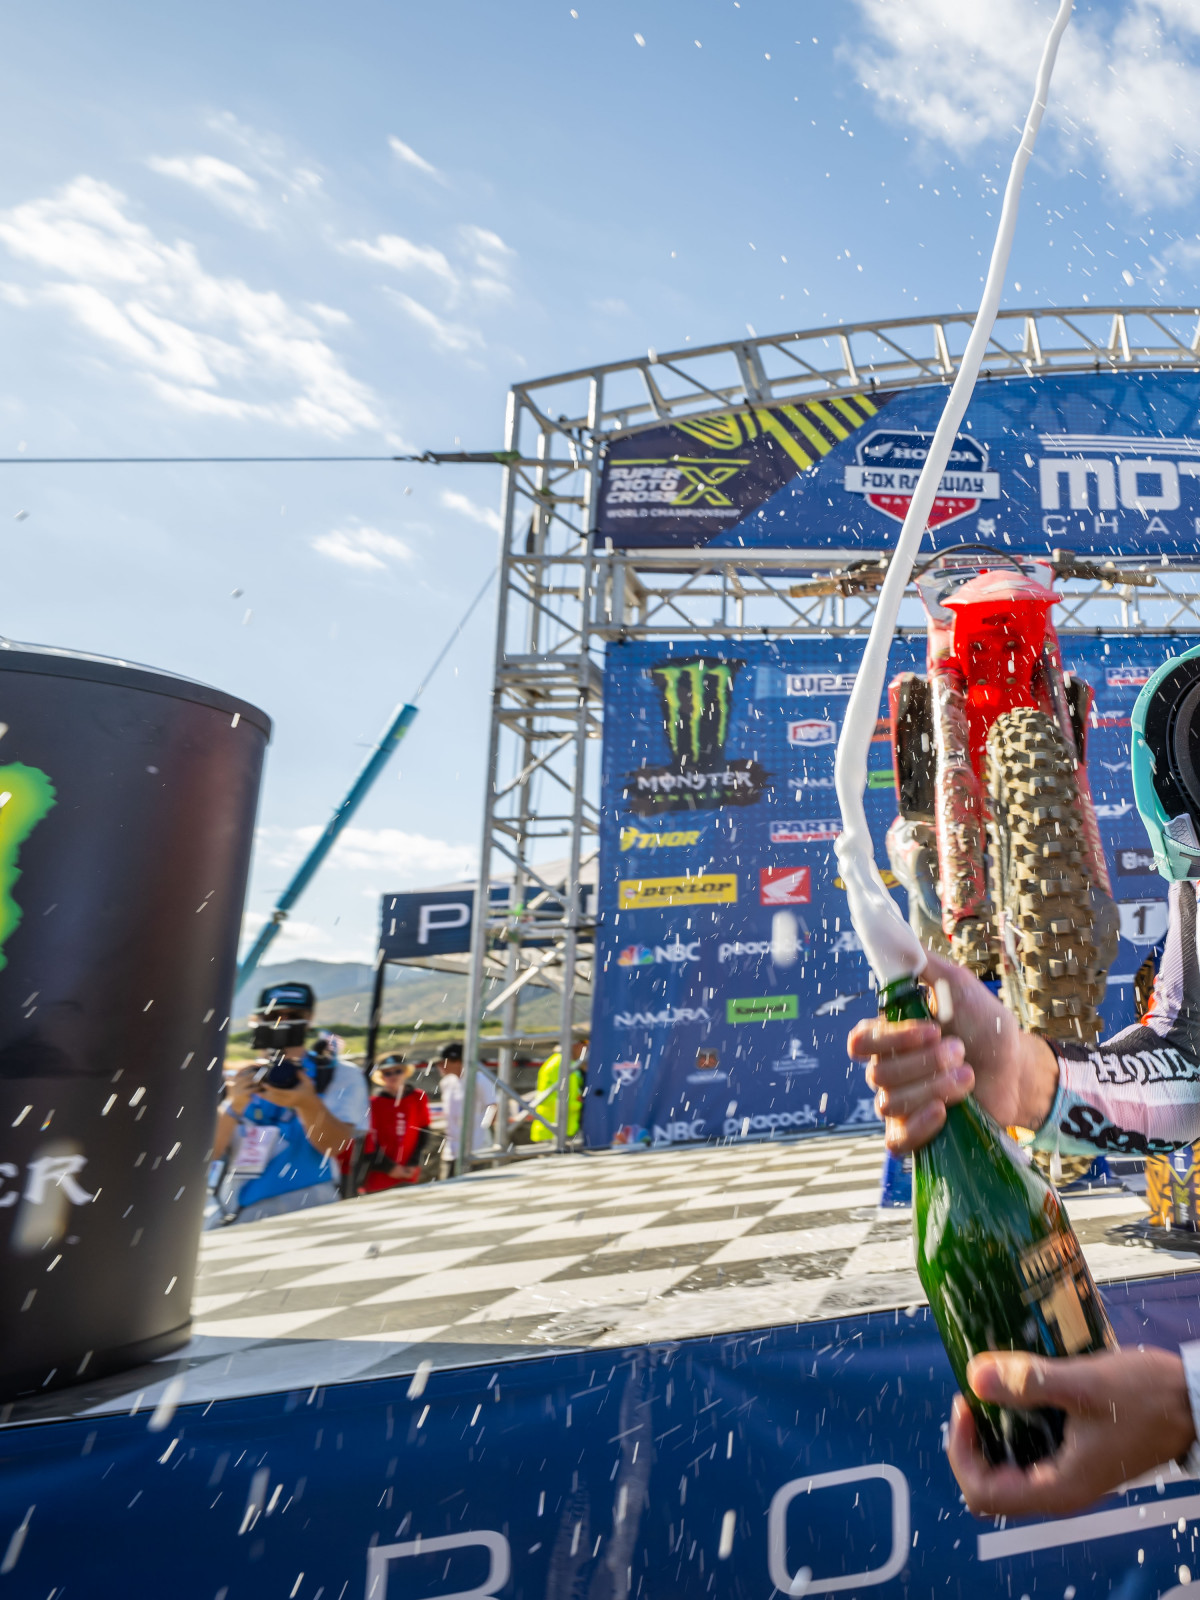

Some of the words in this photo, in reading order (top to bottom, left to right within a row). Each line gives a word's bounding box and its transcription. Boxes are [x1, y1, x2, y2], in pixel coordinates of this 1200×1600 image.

[893, 447, 979, 463] HODA
[608, 467, 682, 480] SUPER
[611, 479, 678, 491] MOTO
[861, 472, 895, 488] FOX
[898, 475, 985, 493] RAEWAY
[606, 490, 678, 504] CROSS
[607, 509, 649, 518] WORLD
[636, 769, 754, 793] MONSTER
[787, 776, 836, 789] NAMU
[638, 831, 700, 849] THOR
[771, 832, 840, 841] UNLIMIT
[642, 883, 732, 897] DUNLOP
[655, 942, 701, 963] NBC
[718, 938, 804, 964] peack
[613, 1007, 710, 1027] NAMURA
[723, 1104, 817, 1136] peacock
[652, 1120, 706, 1142] NBC
